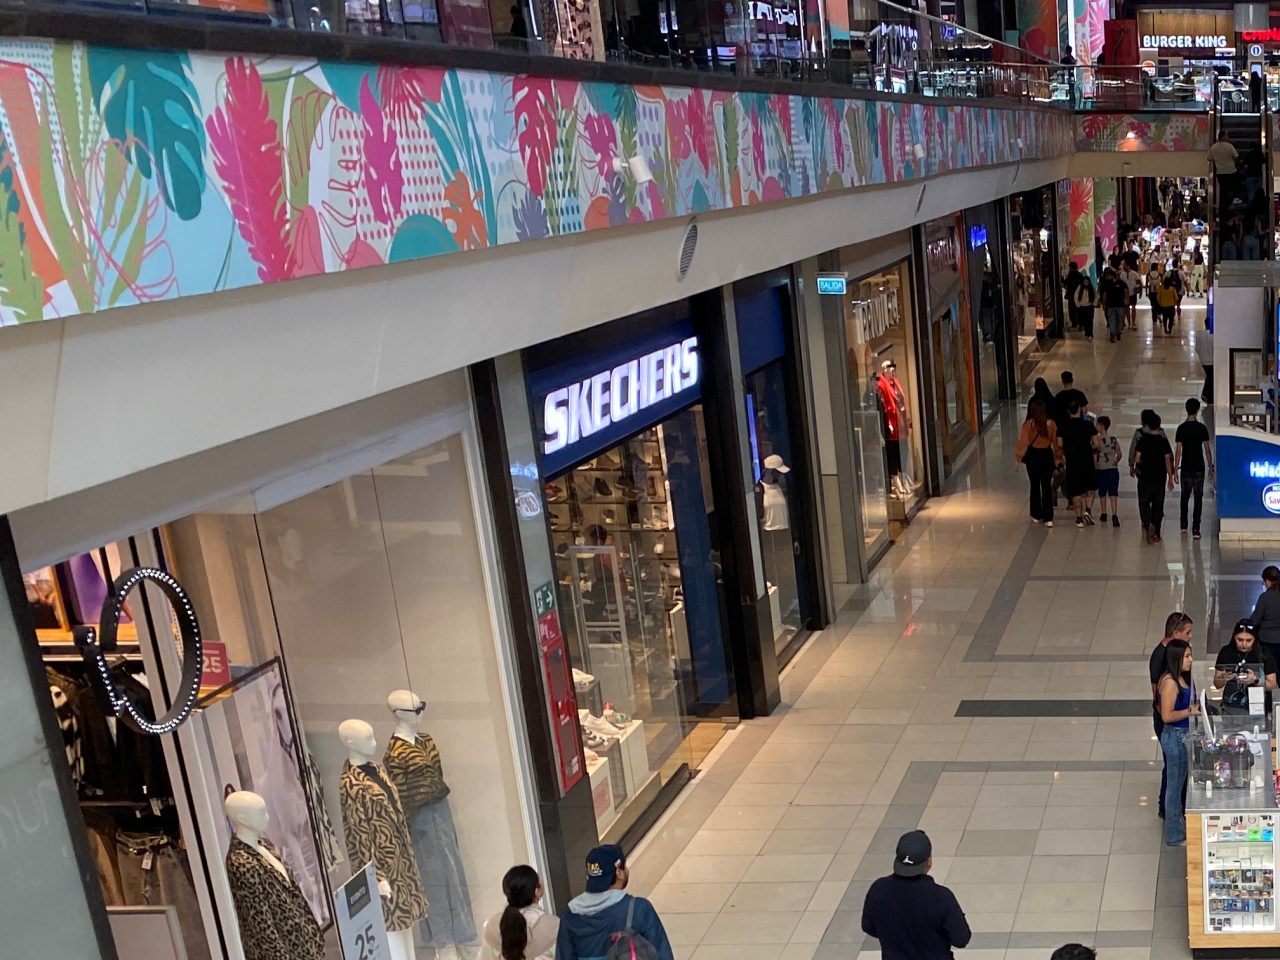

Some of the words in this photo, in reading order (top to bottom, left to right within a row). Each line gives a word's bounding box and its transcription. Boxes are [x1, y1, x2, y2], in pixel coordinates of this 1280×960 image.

[1143, 34, 1192, 48] BURGER
[1195, 34, 1228, 48] KING
[820, 280, 842, 289] SALIDA
[544, 336, 700, 455] SKECHERS
